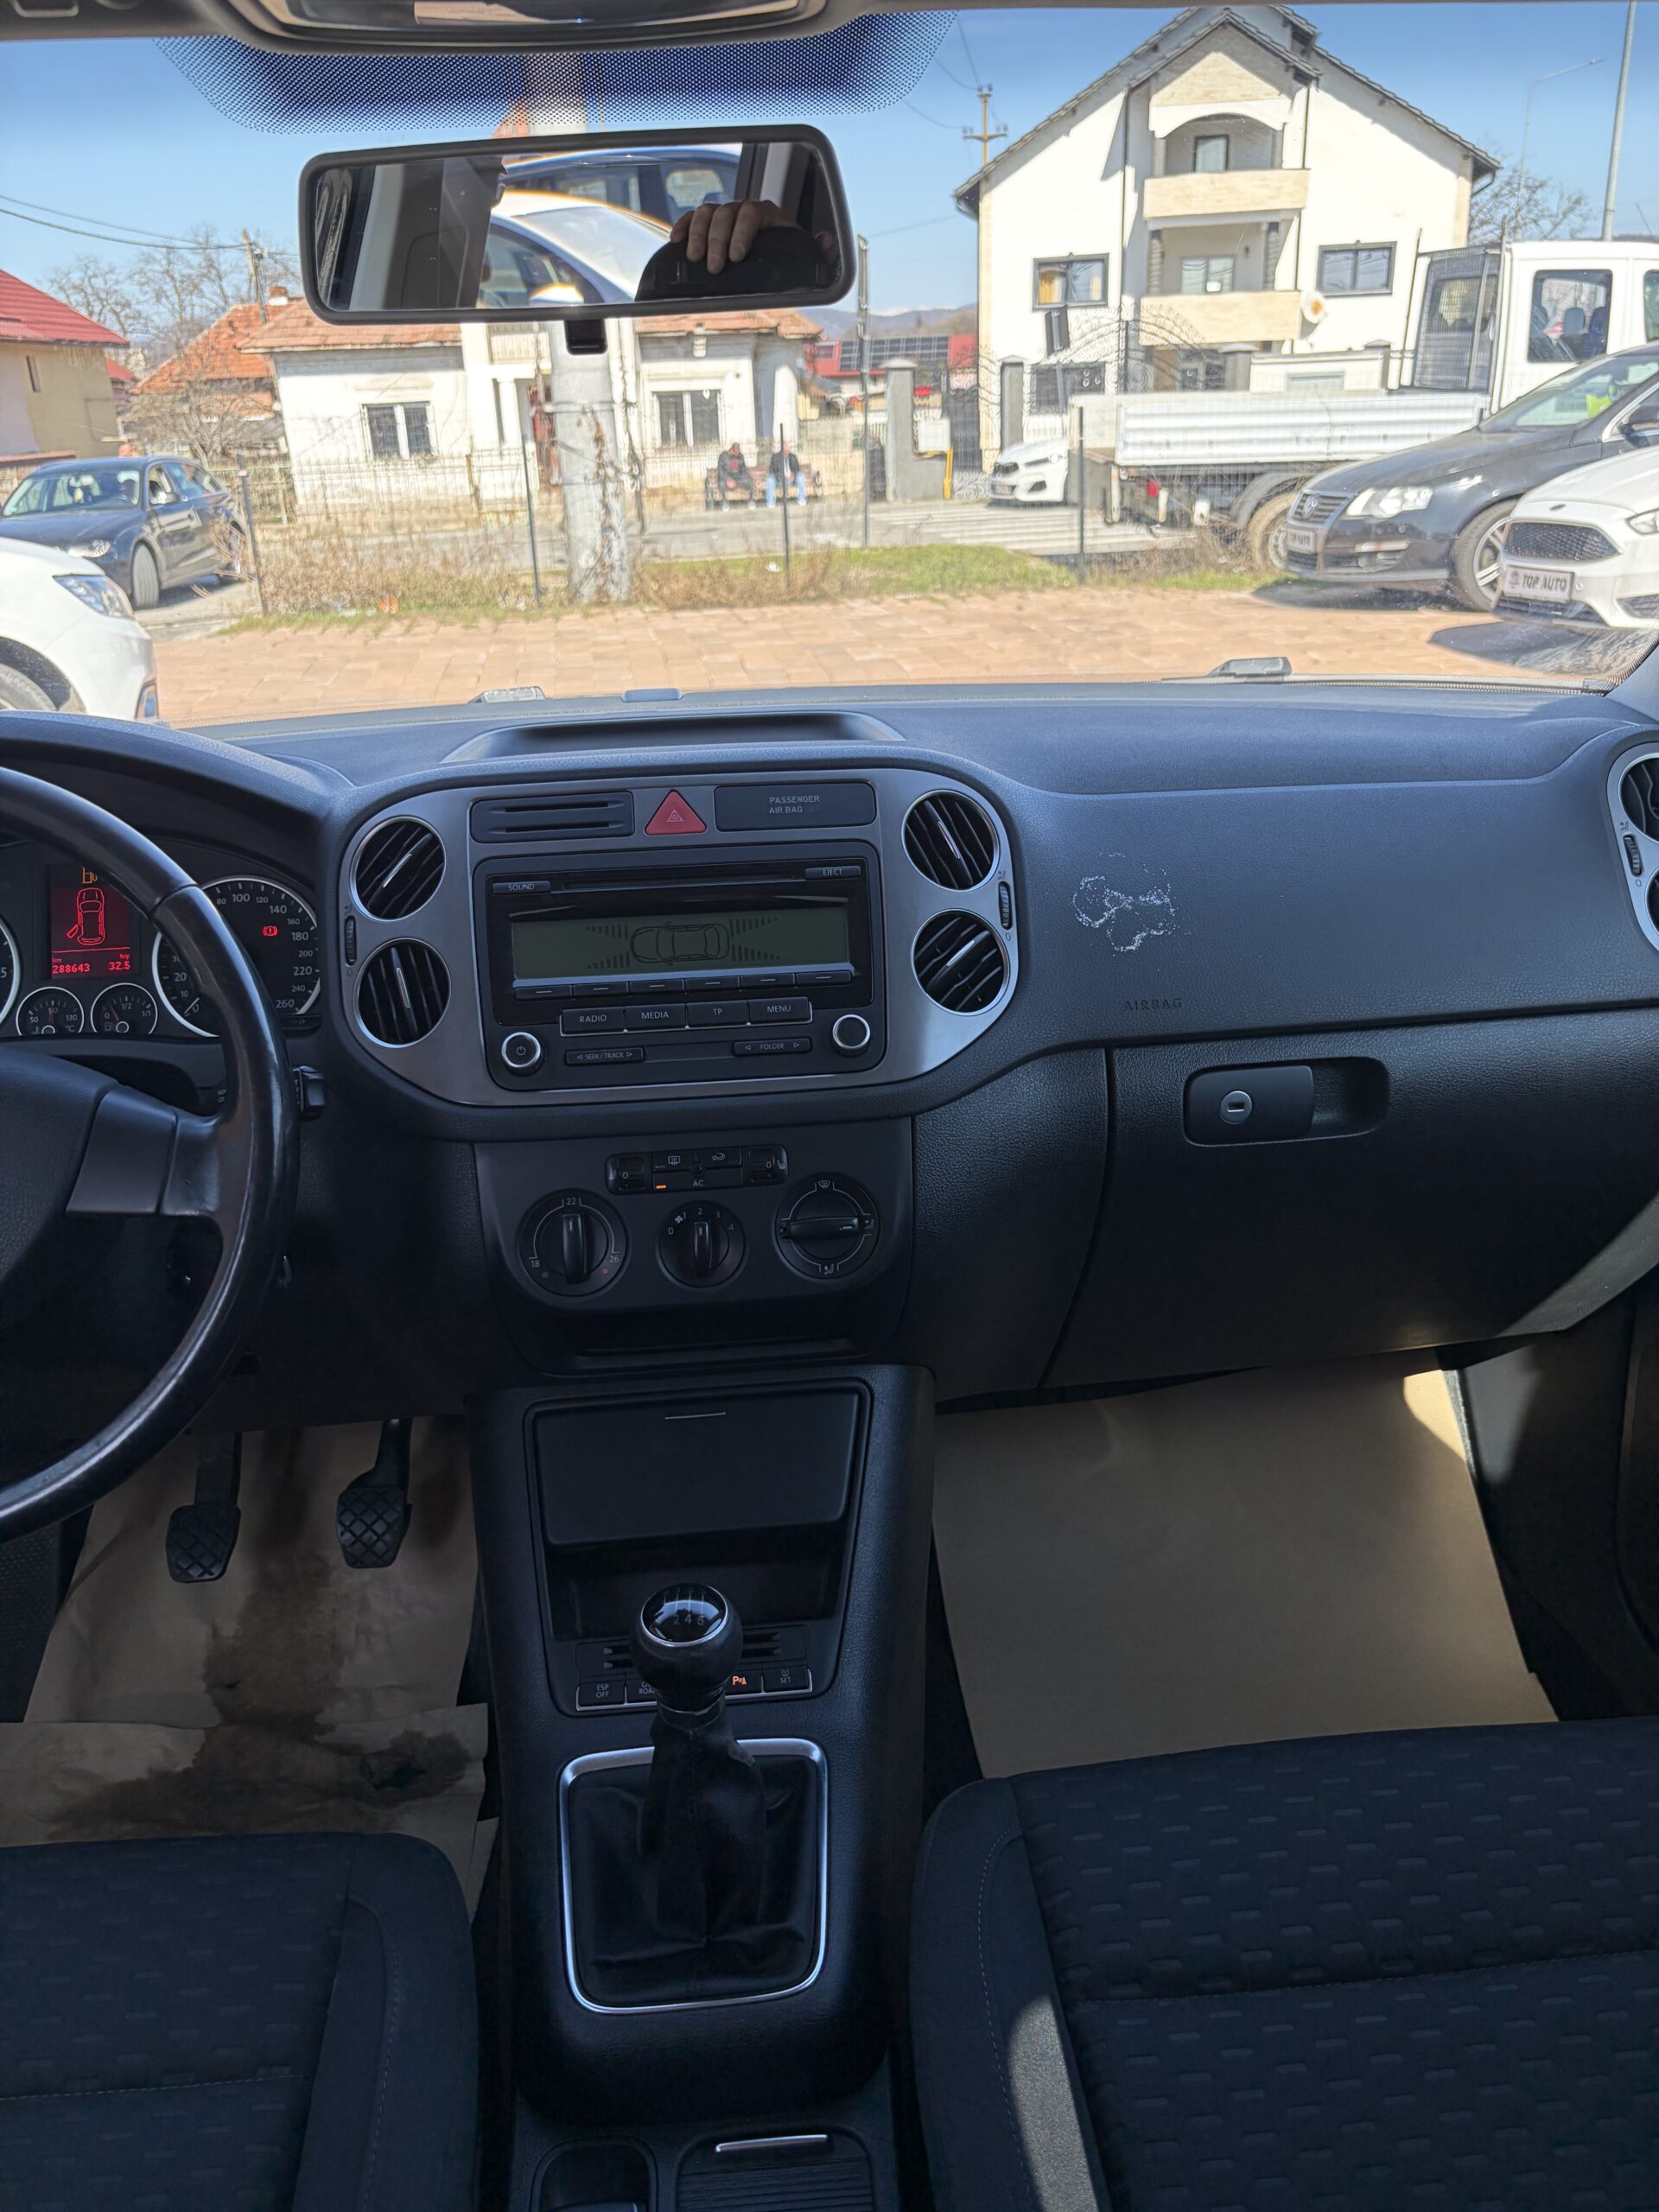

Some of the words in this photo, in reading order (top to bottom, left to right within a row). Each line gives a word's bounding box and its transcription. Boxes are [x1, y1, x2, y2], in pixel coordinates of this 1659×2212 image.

[1541, 576, 1567, 592] AUTO
[769, 795, 820, 804] PASSENGER
[508, 883, 535, 892] SOUND
[232, 893, 251, 903] 100
[270, 905, 287, 914] 140
[291, 931, 309, 941] 180
[52, 963, 91, 975] 288643
[109, 961, 130, 971] 32.5
[293, 966, 313, 976] 220
[175, 972, 188, 982] 20
[291, 984, 306, 993] 240
[276, 999, 295, 1009] 260
[1124, 997, 1182, 1011] AIRBAG
[766, 1005, 791, 1014] MENU
[66, 1014, 78, 1022] 130
[579, 1014, 607, 1024] RADIO
[641, 1011, 670, 1020] MEDIA
[697, 1207, 704, 1216] 2
[715, 1211, 721, 1219] 3
[531, 1259, 540, 1268] 18
[684, 1613, 692, 1624] 4
[696, 1616, 705, 1625] 6
